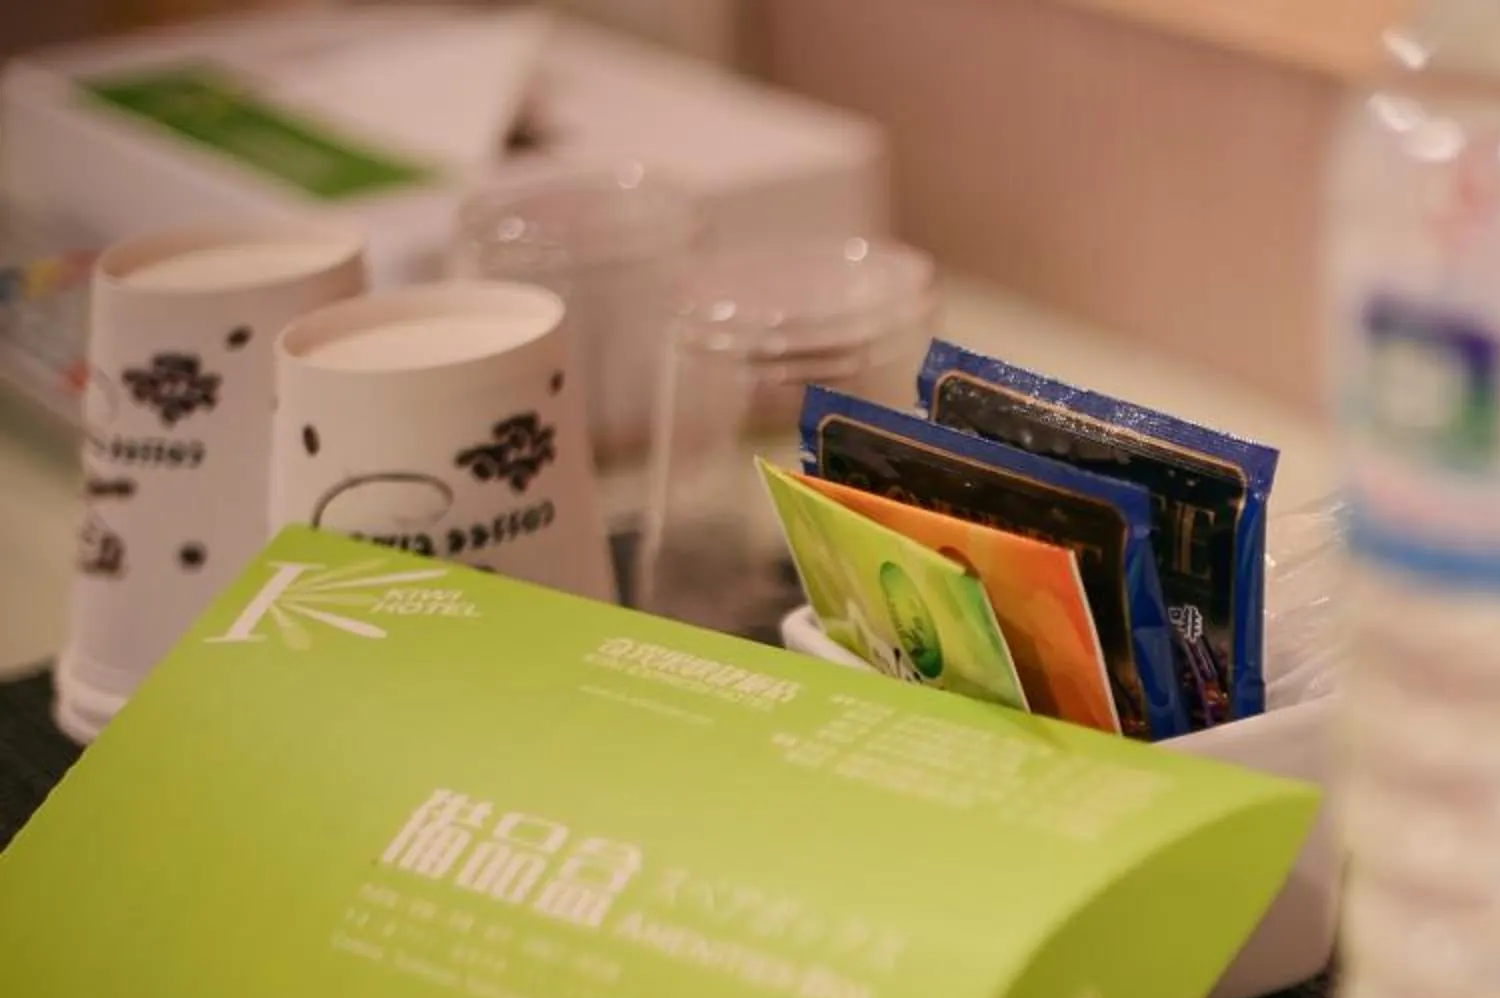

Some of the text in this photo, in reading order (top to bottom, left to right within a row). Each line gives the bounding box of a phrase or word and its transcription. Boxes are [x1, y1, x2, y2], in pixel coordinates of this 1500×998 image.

[448, 499, 557, 553] coffee
[379, 586, 465, 602] KIWI
[368, 599, 485, 618] HOTEL
